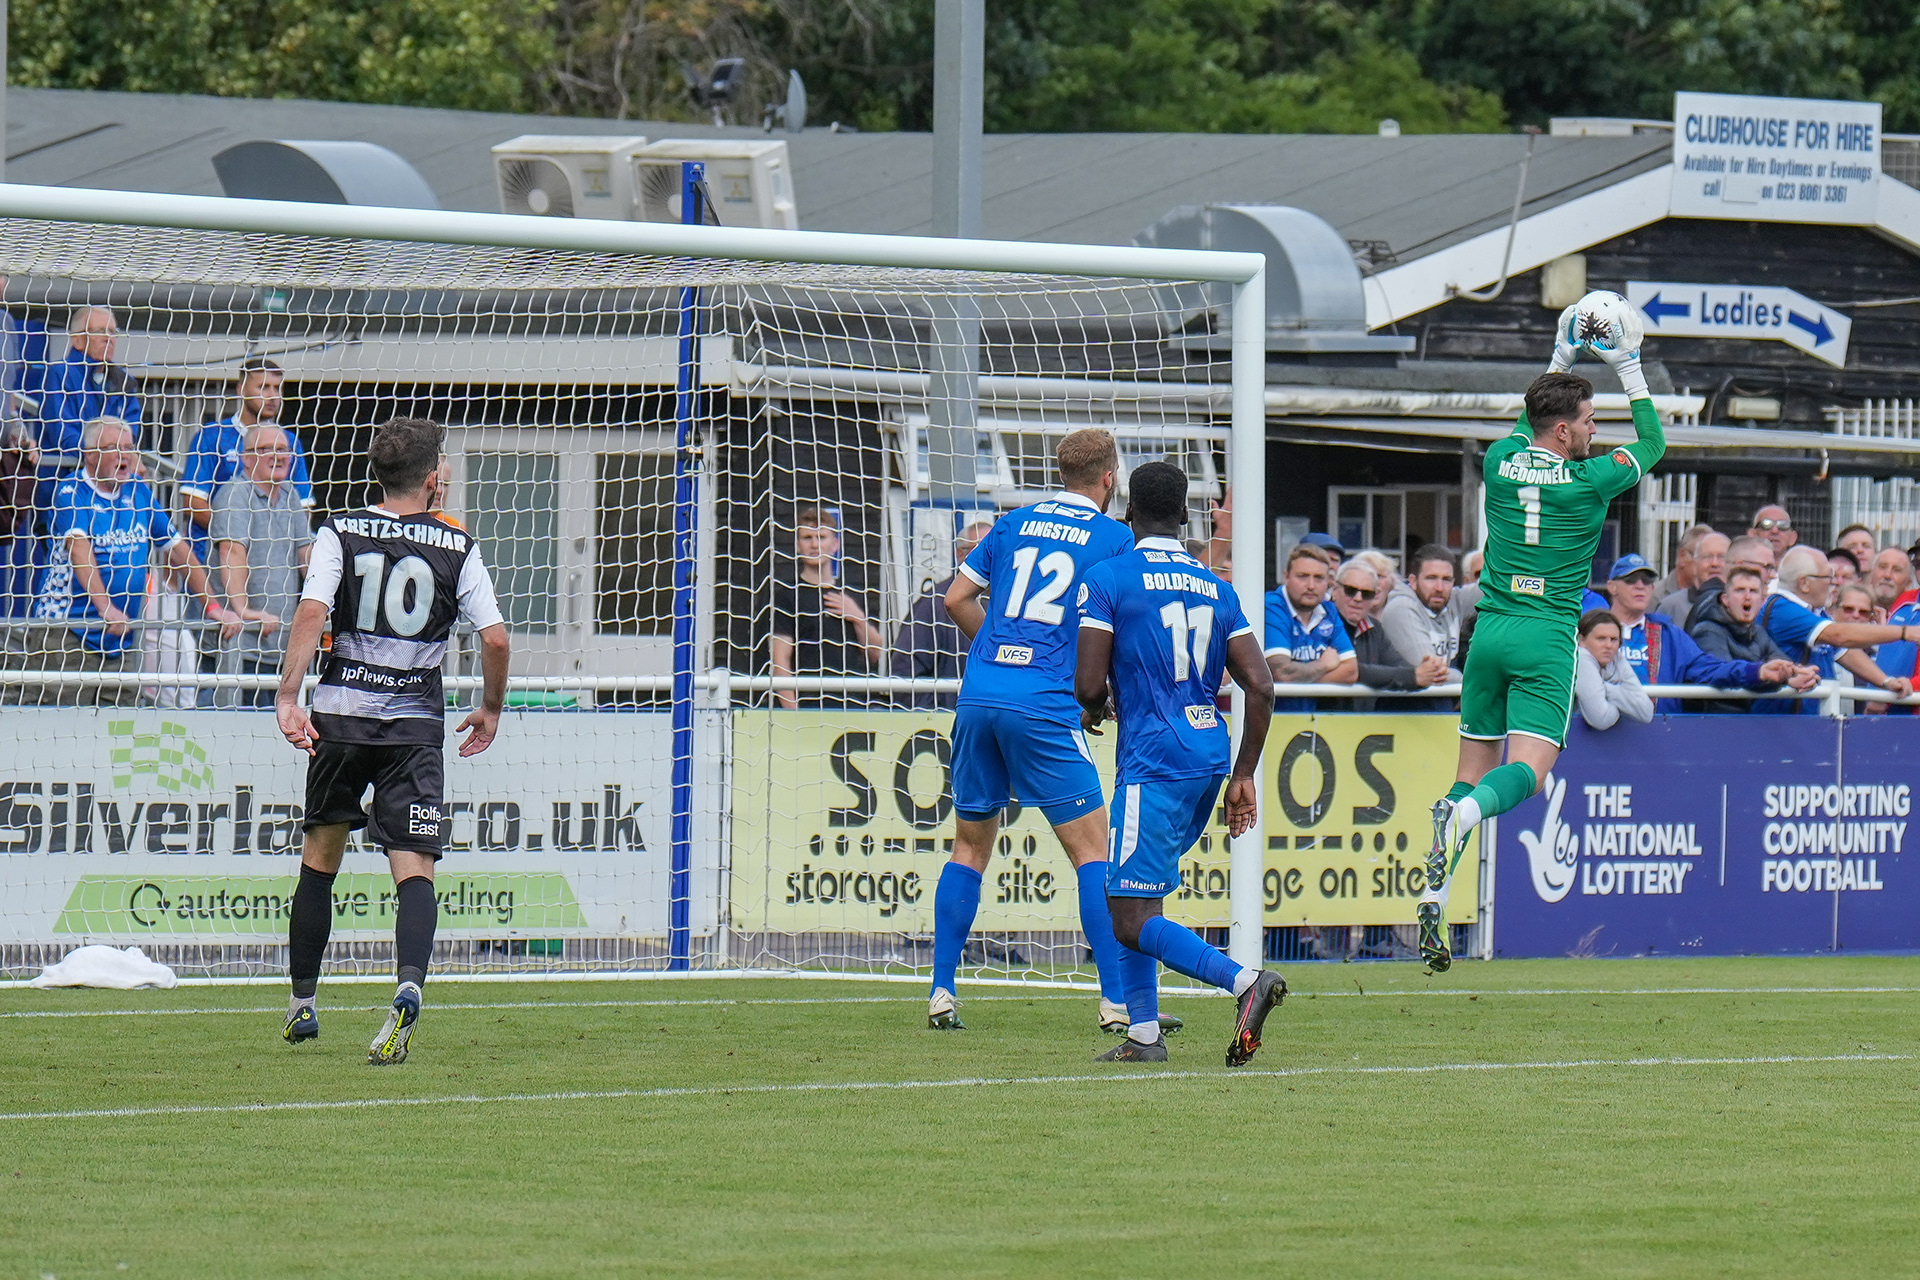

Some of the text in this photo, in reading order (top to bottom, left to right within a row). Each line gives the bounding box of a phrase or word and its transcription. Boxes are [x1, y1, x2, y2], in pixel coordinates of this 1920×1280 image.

[1686, 114, 1874, 152] CLUBHOUSE FOR HIRE
[1684, 154, 1873, 183] Available for Hire Daytimes or Evenings
[1703, 179, 1721, 196] call
[1776, 183, 1796, 200] 023
[1701, 292, 1782, 327] Ladies
[1517, 487, 1541, 545] 1
[333, 518, 468, 554] KRETZSCHMAR
[1019, 520, 1091, 546] LANGSTON
[353, 552, 436, 637] 10
[1005, 546, 1075, 625] 12
[1142, 572, 1219, 600] BOLDEWIJN
[1516, 578, 1541, 590] VFS
[1003, 649, 1029, 660] VFS
[1159, 600, 1214, 682] 11
[1190, 708, 1212, 720] VFS
[829, 729, 1022, 831] SO
[409, 805, 441, 823] Rolfe
[1584, 785, 1632, 818] THE
[1763, 785, 1911, 818] SUPPORTING
[409, 820, 439, 837] East
[1584, 824, 1702, 857] NATIONAL
[1763, 823, 1907, 855] COMMUNITY
[786, 859, 1056, 917] storage site
[1129, 880, 1166, 890] Matrix IT
[1177, 854, 1427, 912] stoge on site
[1762, 860, 1883, 893] FOOTBALL
